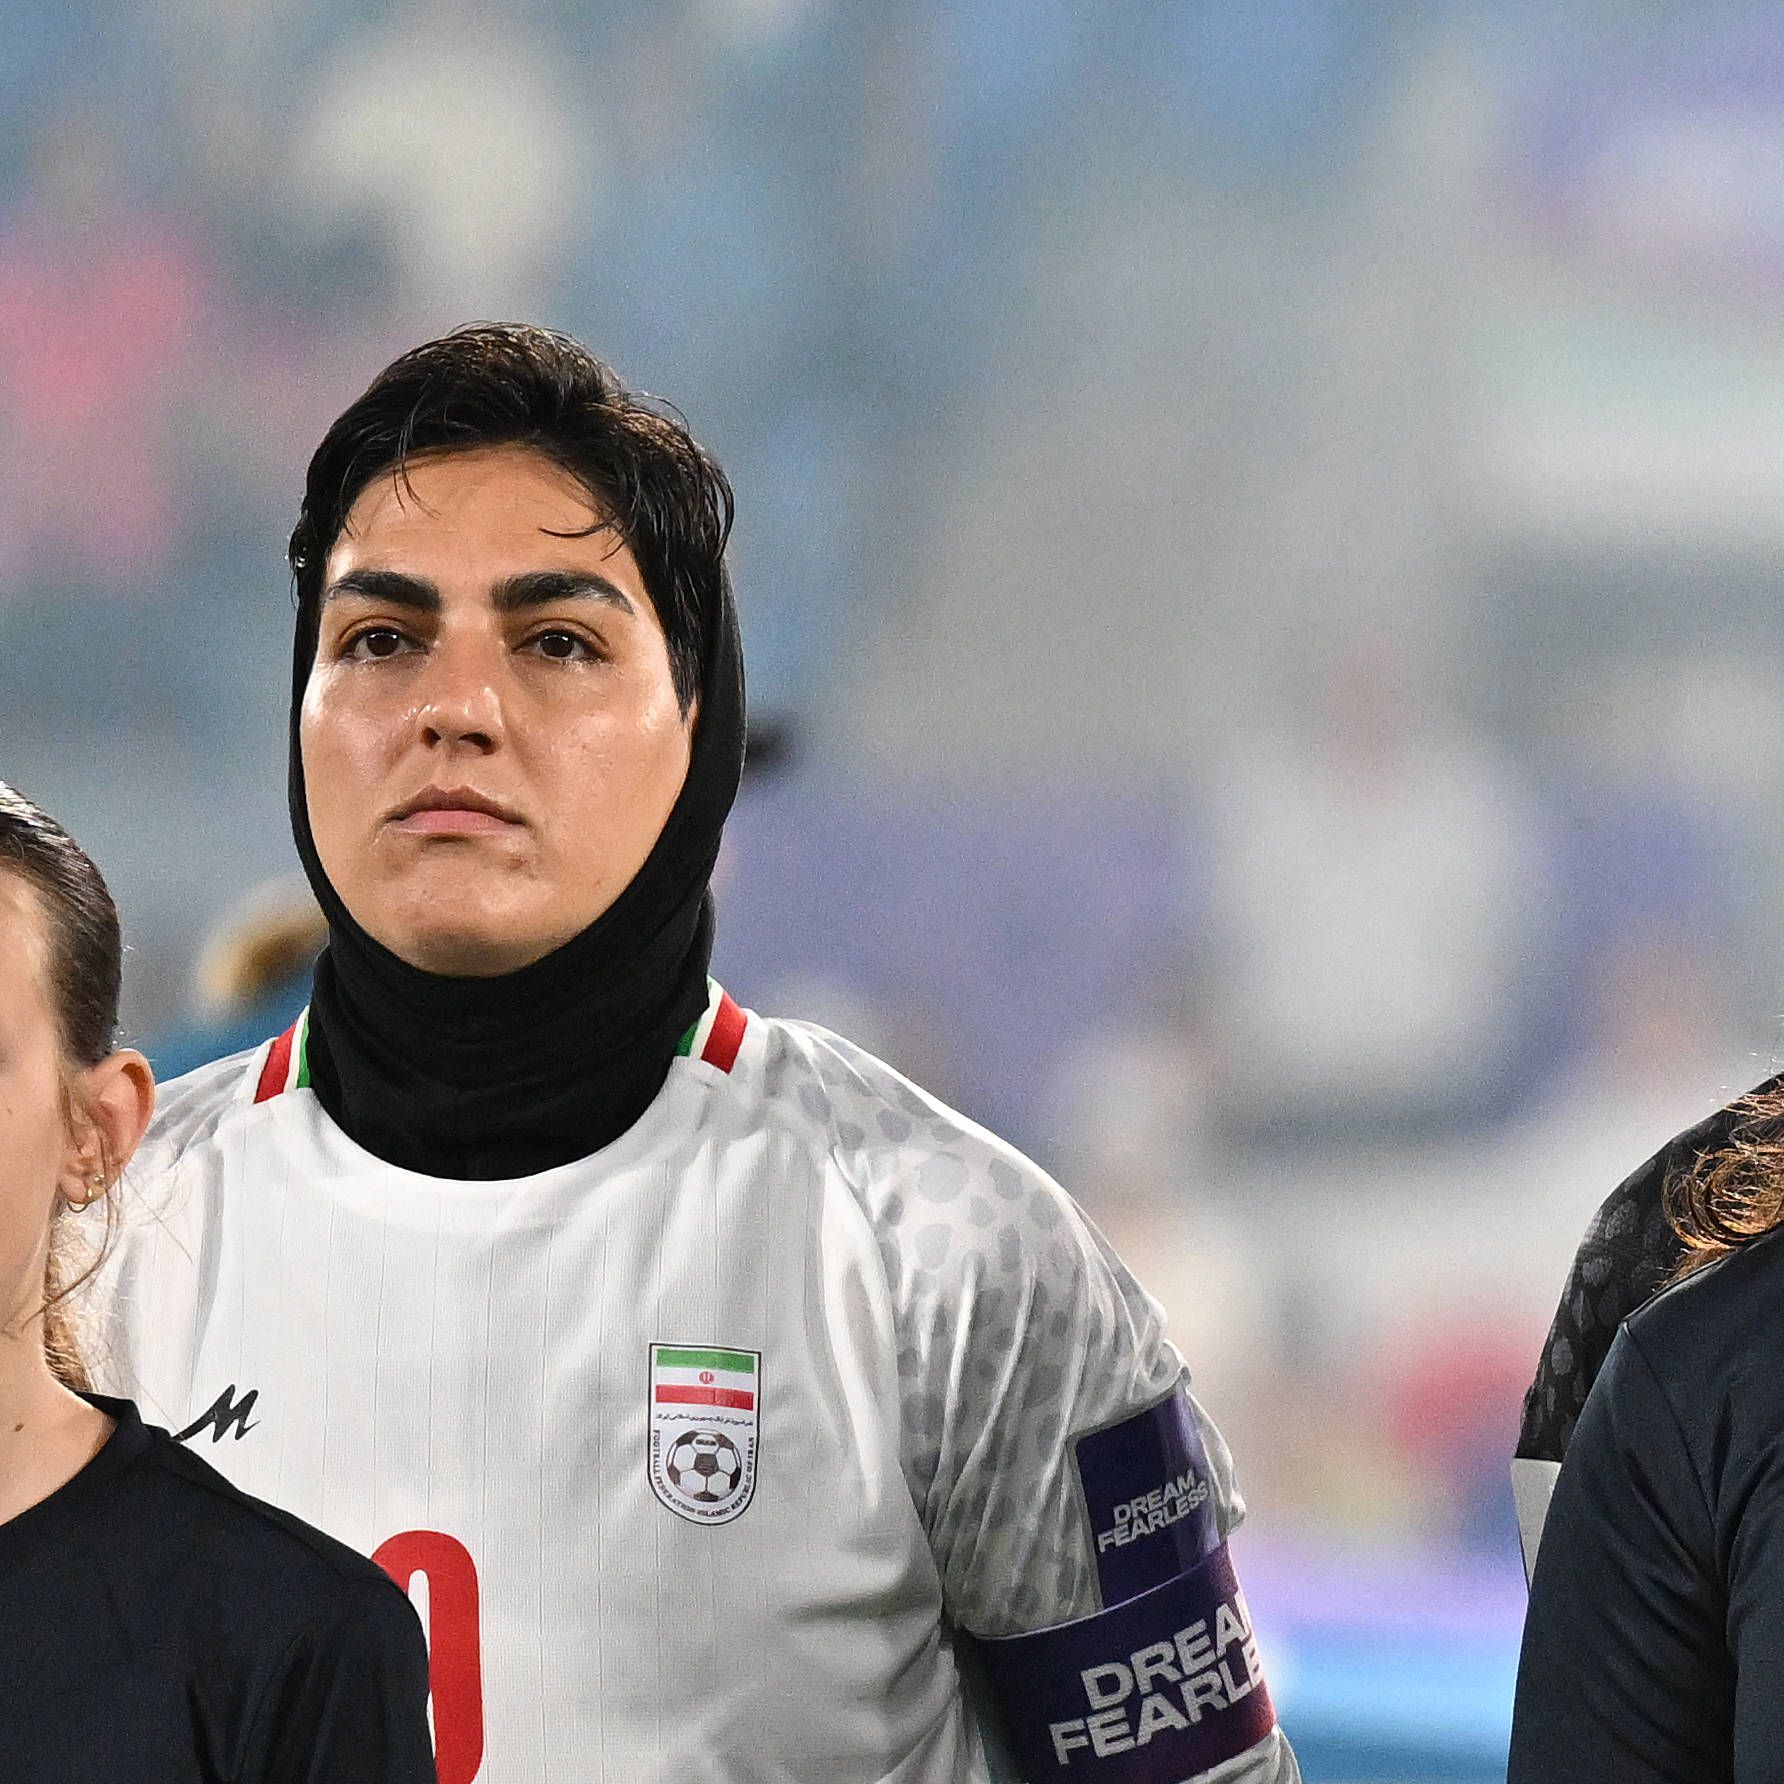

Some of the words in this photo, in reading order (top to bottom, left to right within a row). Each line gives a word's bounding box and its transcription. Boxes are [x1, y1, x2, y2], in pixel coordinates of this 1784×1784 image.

[1097, 1481, 1210, 1553] FEARLESS
[1113, 1469, 1196, 1525] DREAM
[1081, 1593, 1252, 1711] DREA
[1049, 1645, 1264, 1765] FEARLE
